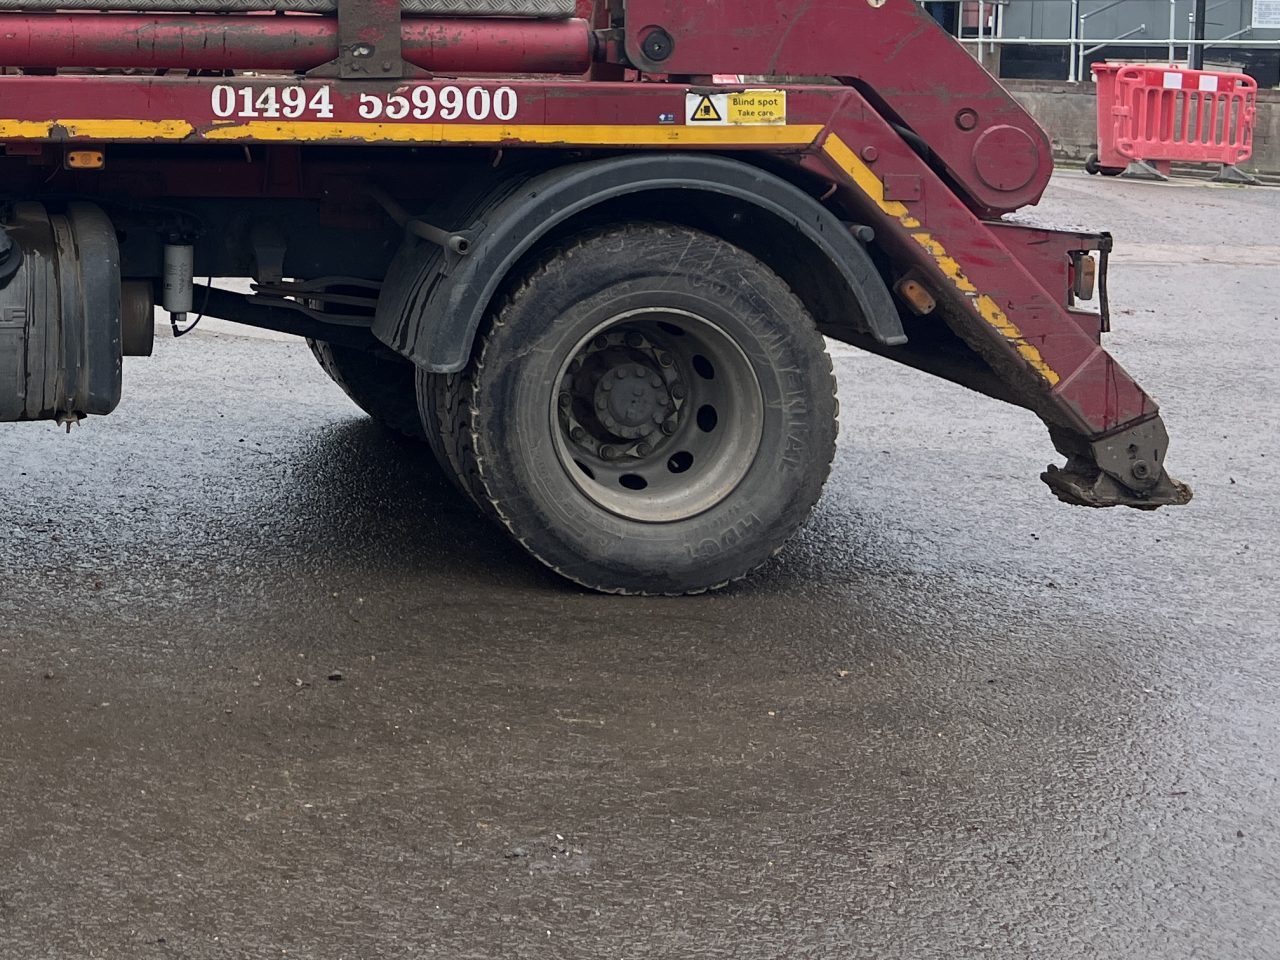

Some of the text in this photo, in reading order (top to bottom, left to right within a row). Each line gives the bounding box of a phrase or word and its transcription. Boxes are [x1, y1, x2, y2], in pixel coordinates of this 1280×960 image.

[211, 84, 518, 120] 01494 559900
[733, 98, 778, 108] Blind spot
